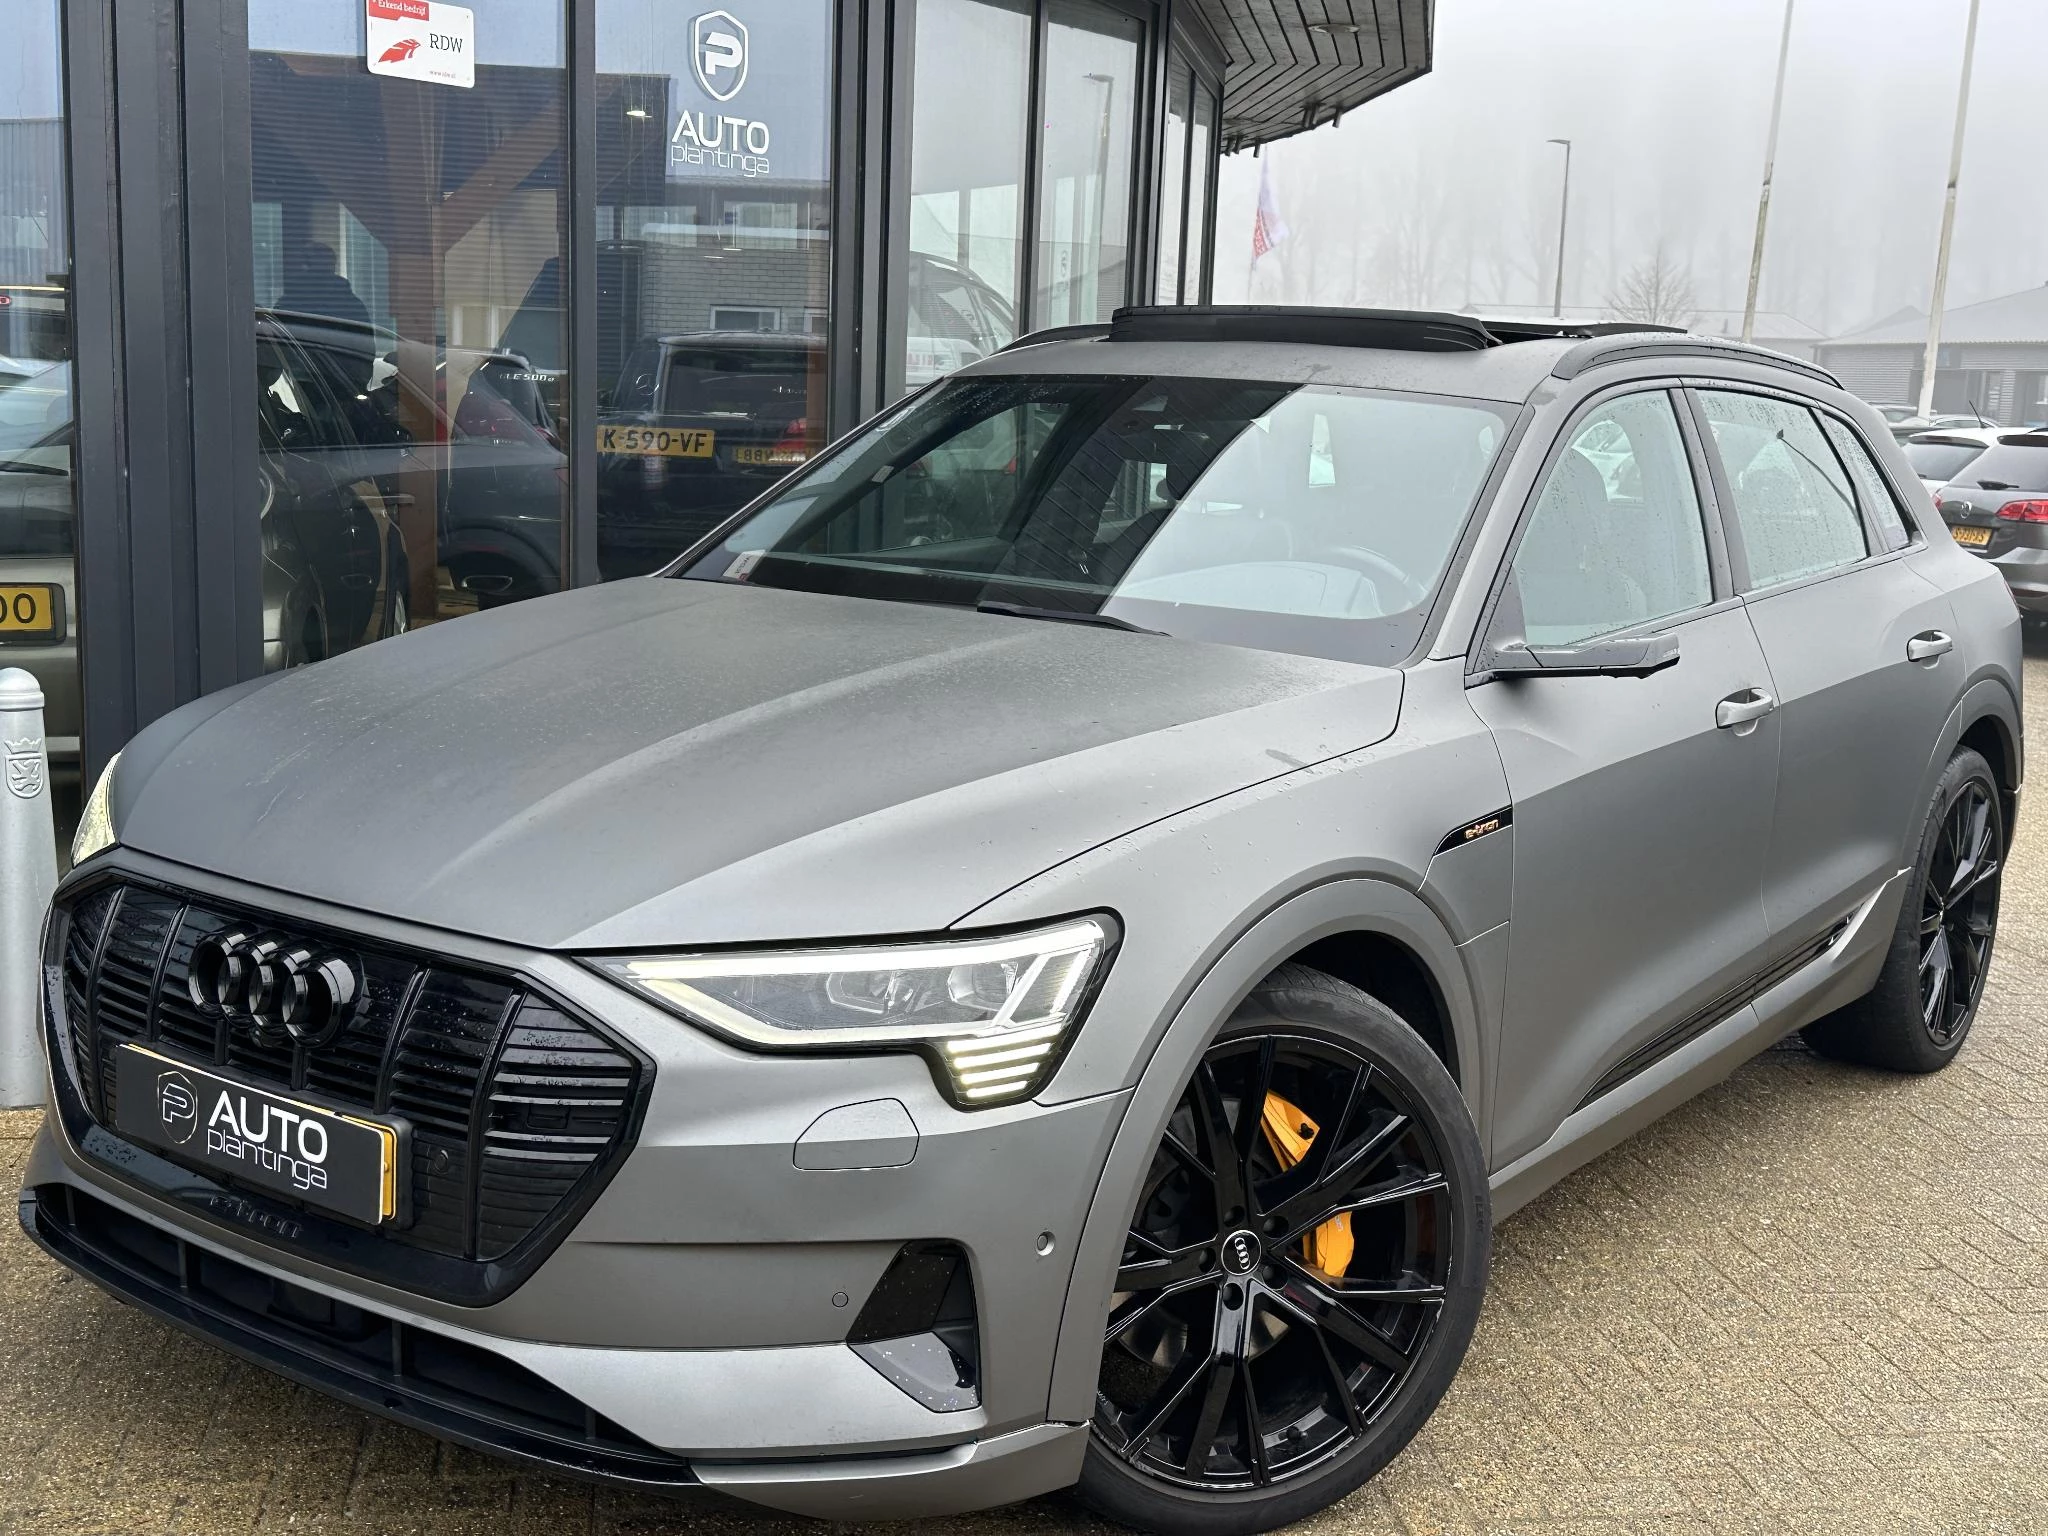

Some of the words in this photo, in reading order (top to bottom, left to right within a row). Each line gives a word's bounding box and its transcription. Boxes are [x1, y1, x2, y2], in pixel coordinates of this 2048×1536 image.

[378, 0, 403, 11] Erkend
[403, 3, 426, 16] bedrijf
[429, 32, 464, 54] RDW
[671, 109, 770, 155] AUTO
[671, 143, 770, 178] plantinga
[603, 428, 708, 453] K-590-VF
[1465, 819, 1499, 839] e-tron
[207, 1089, 328, 1164] AUTO
[206, 1128, 328, 1191] plantinga
